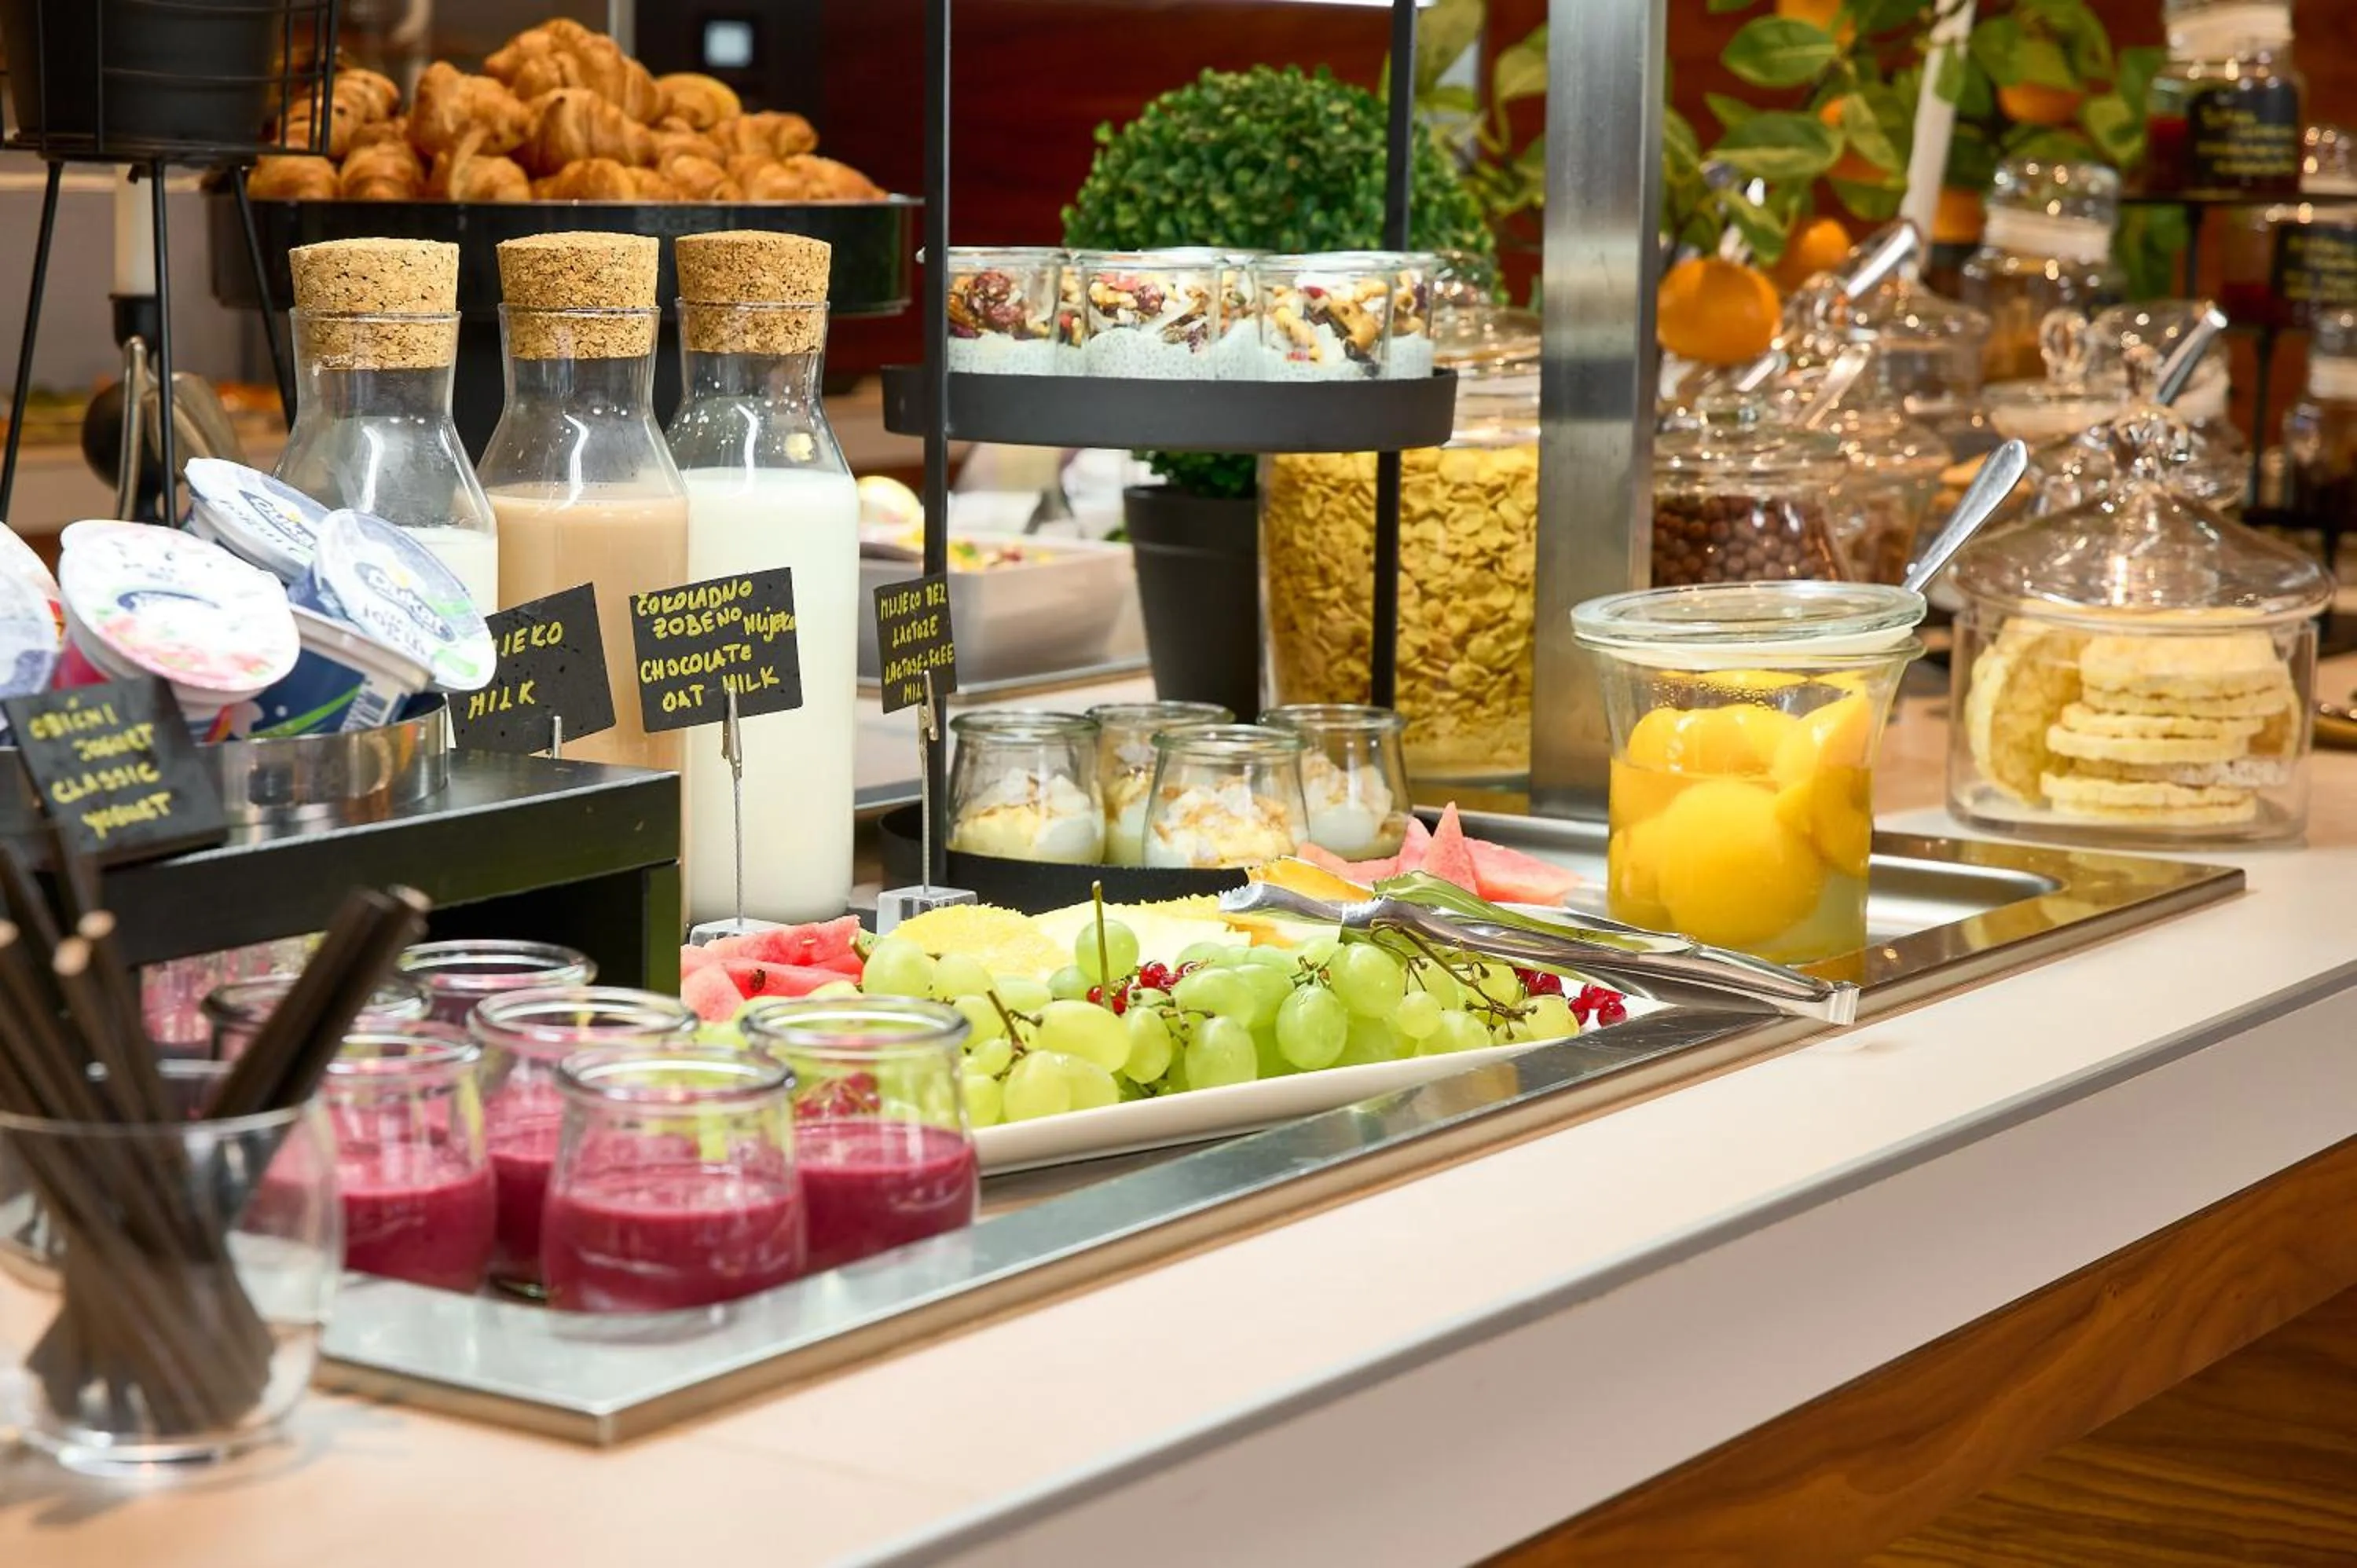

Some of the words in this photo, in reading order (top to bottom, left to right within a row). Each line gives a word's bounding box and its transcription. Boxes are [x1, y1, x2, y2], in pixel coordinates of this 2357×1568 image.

[653, 607, 742, 639] ZOBENO
[467, 680, 535, 720] MILK
[662, 684, 705, 713] OAT
[722, 666, 779, 694] MILK
[904, 682, 924, 705] MIL
[50, 761, 161, 804] CLASSIC
